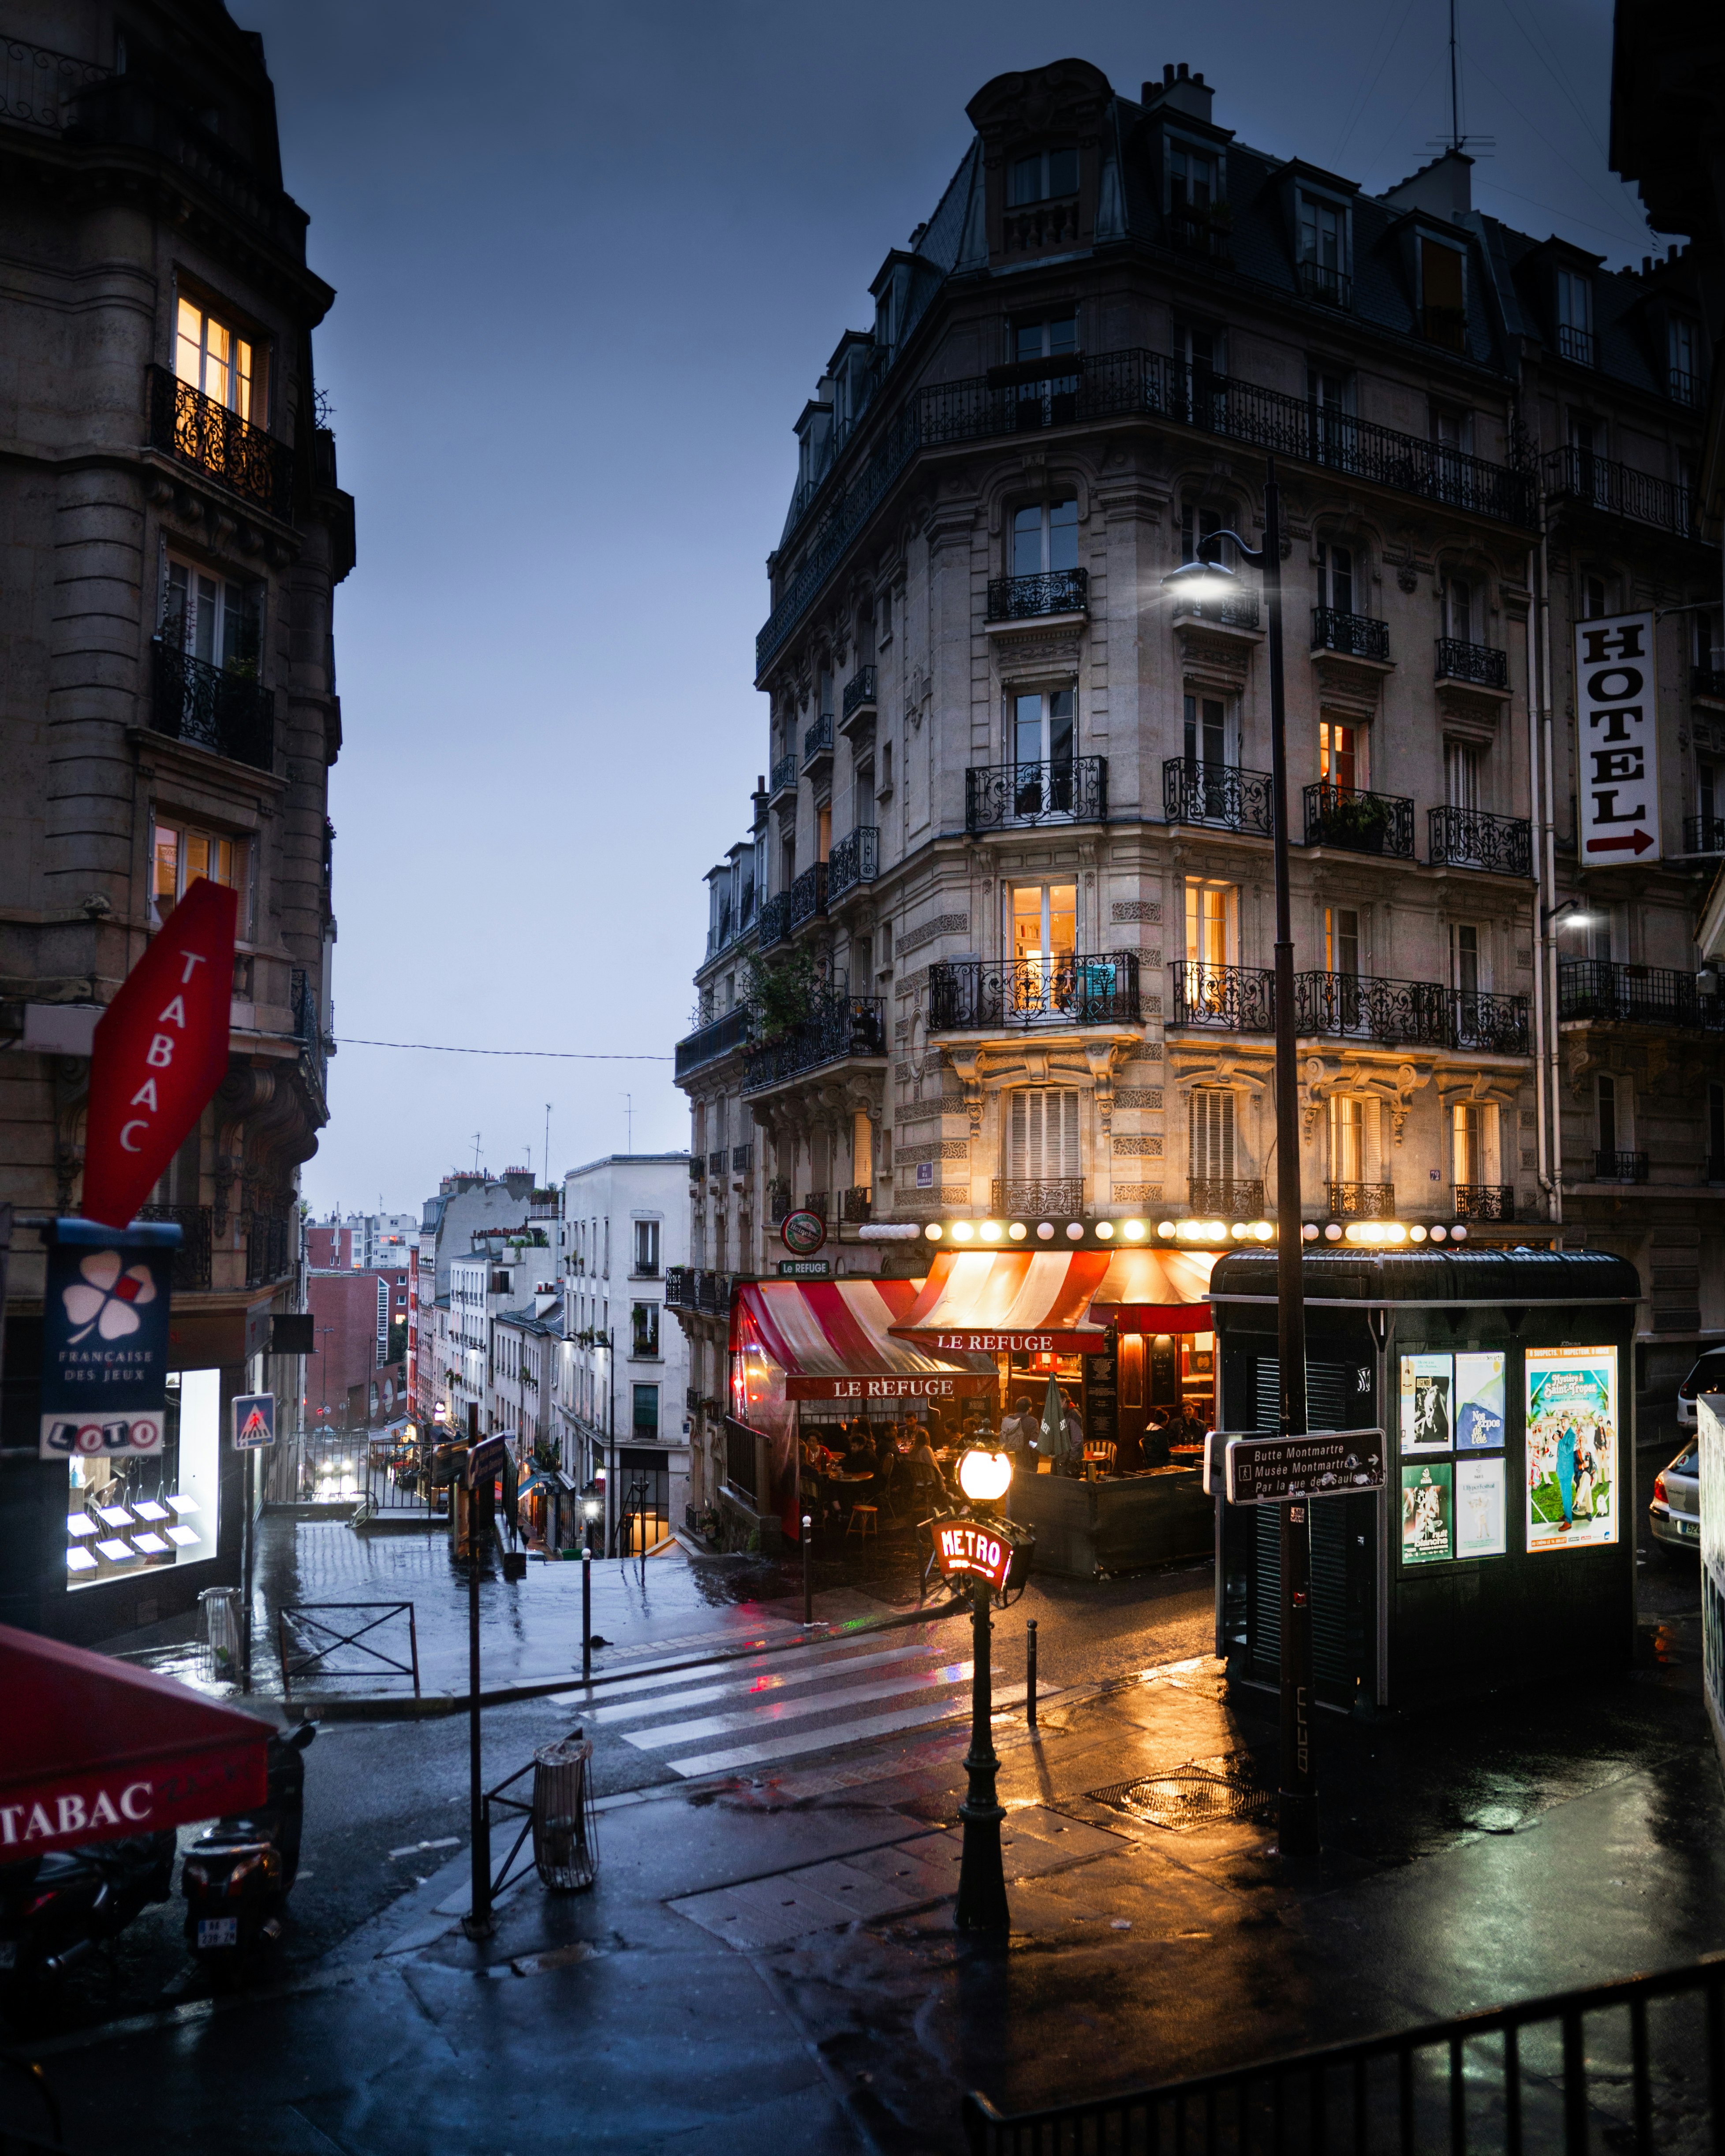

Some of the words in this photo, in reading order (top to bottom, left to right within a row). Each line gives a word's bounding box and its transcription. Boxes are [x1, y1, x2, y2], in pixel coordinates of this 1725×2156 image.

[1583, 624, 1646, 824] HOTEL
[119, 951, 206, 1153] TABAC
[1431, 1171, 1439, 1180] 72
[790, 1223, 819, 1241] Heineken
[783, 1264, 793, 1273] Le
[795, 1263, 826, 1272] REFUGE
[937, 1335, 963, 1349] LE
[968, 1336, 1053, 1351] REFUGE
[64, 1369, 96, 1381] DES
[103, 1369, 145, 1382] JEUX
[1552, 1373, 1579, 1387] Mystère
[1579, 1372, 1584, 1383] à
[834, 1381, 861, 1397] LE
[867, 1380, 954, 1396] REFUGE
[1544, 1382, 1597, 1399] Saint-Tropez
[1472, 1410, 1486, 1421] Nos
[1473, 1425, 1482, 1435] de
[1477, 1419, 1501, 1431] expos
[48, 1420, 158, 1454] LOTO
[1254, 1450, 1282, 1462] Butte
[1286, 1444, 1344, 1458] Montmartre
[1679, 1456, 1687, 1465] A
[1255, 1464, 1288, 1477] Musée
[1255, 1481, 1273, 1493] Par
[1277, 1480, 1285, 1491] la
[1310, 1476, 1326, 1486] de
[1331, 1472, 1358, 1485] Saul
[1432, 1529, 1448, 1538] nuit
[941, 1529, 1002, 1567] METRO
[1414, 1537, 1449, 1547] blanche
[0, 1781, 153, 1846] TABAC
